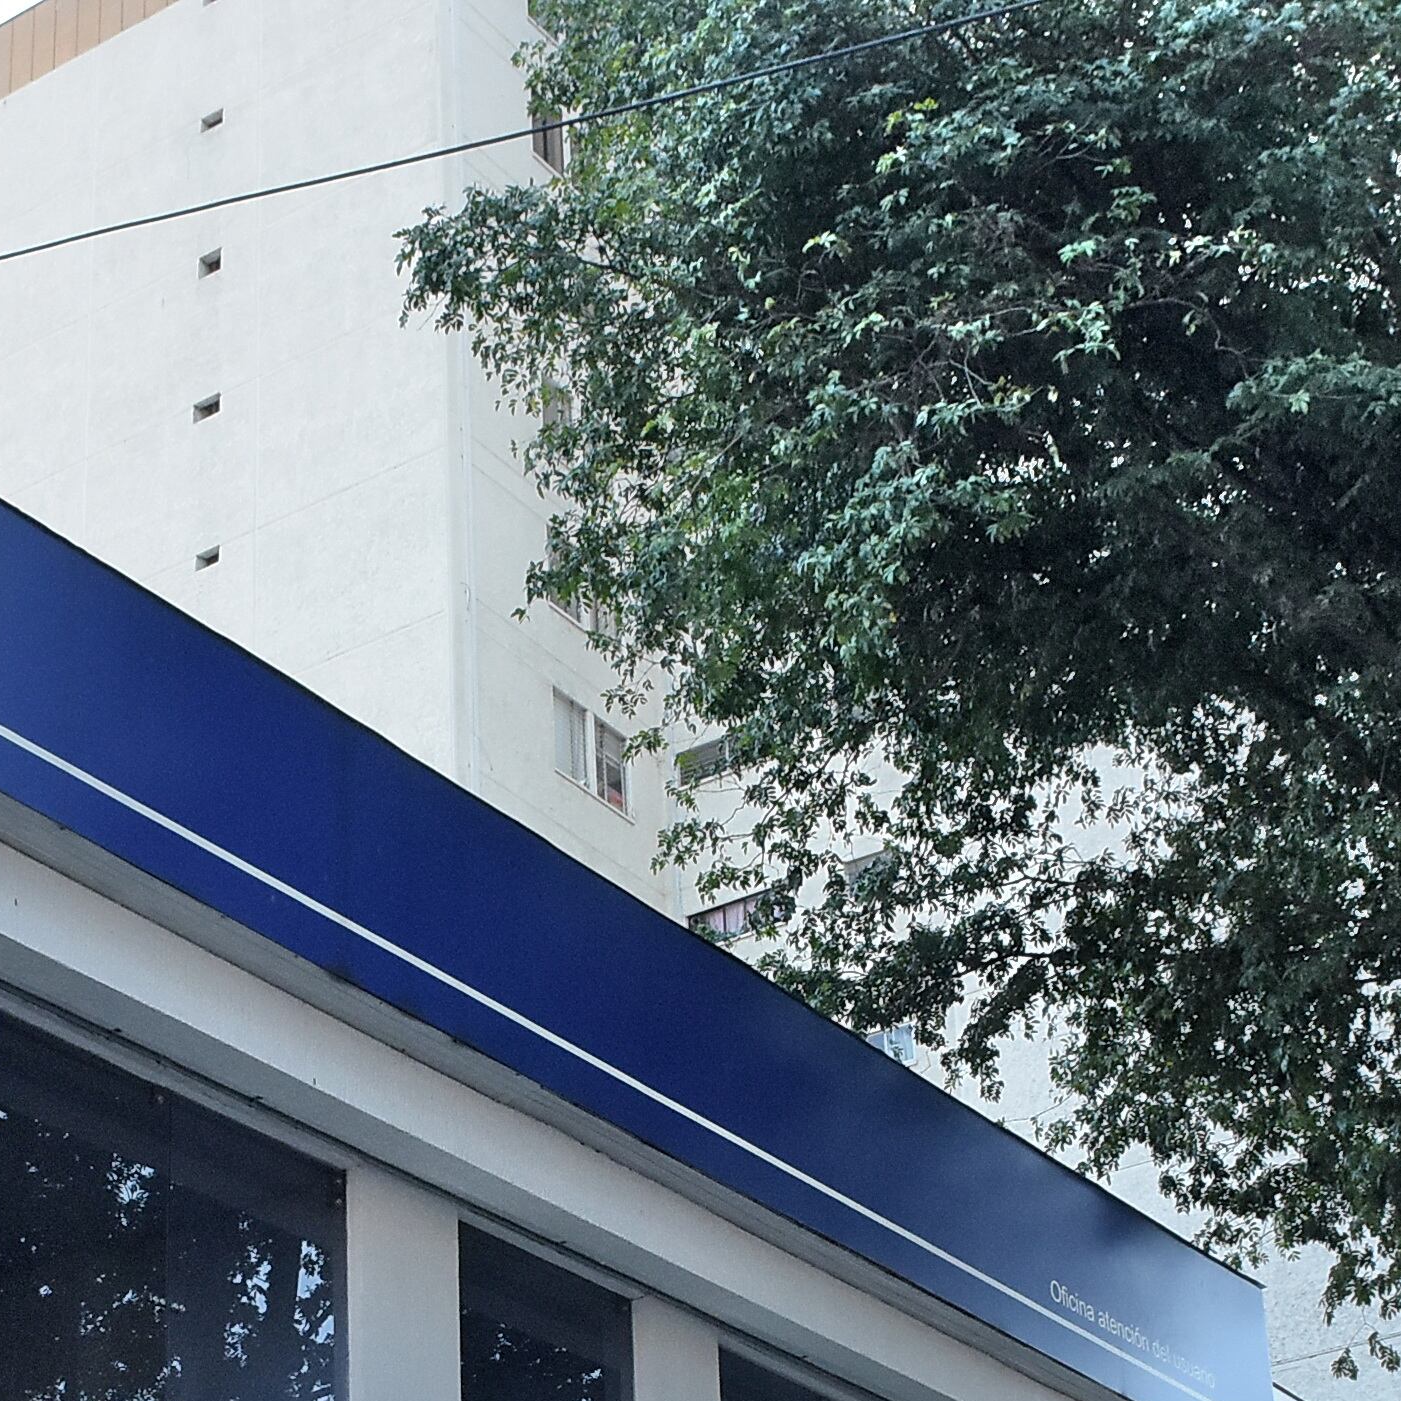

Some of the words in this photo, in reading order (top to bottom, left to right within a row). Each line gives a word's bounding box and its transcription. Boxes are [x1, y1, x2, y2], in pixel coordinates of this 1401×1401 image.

[1050, 1279, 1095, 1322] Oficina
[1098, 1311, 1149, 1352] atención
[1152, 1340, 1170, 1364] del
